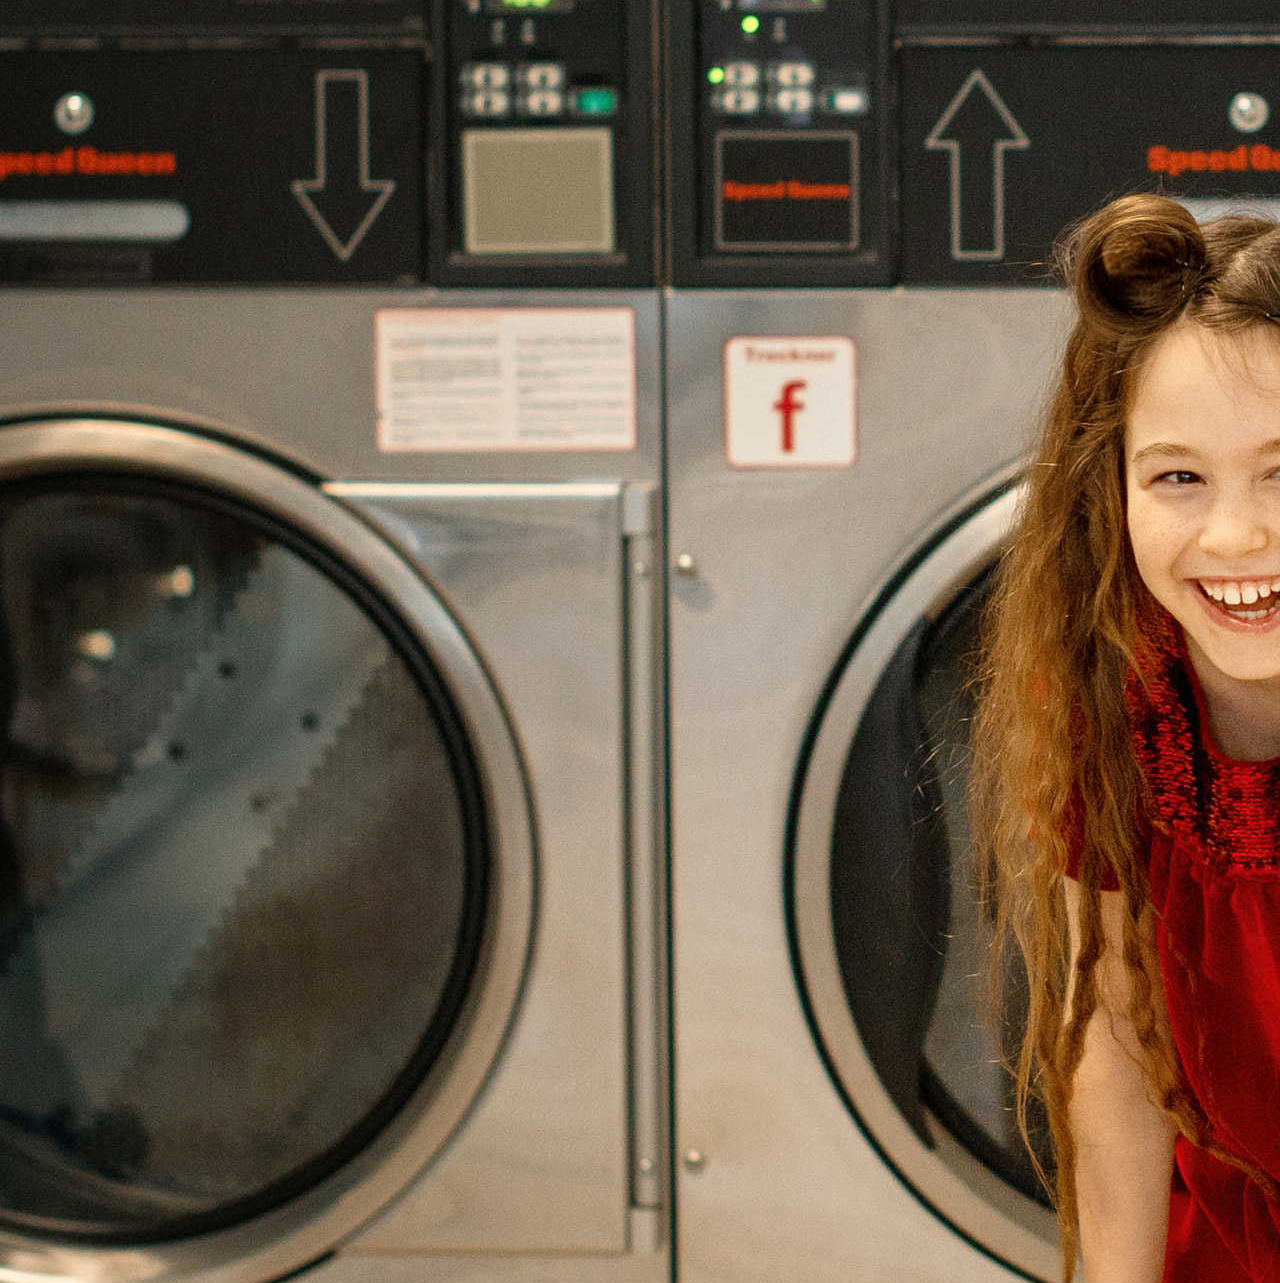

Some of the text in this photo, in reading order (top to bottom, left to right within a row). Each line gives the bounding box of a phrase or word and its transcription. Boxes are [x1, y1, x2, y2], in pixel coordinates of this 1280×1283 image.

[0, 147, 176, 179] peed Queen
[1147, 145, 1247, 176] Speed
[772, 379, 807, 454] f
